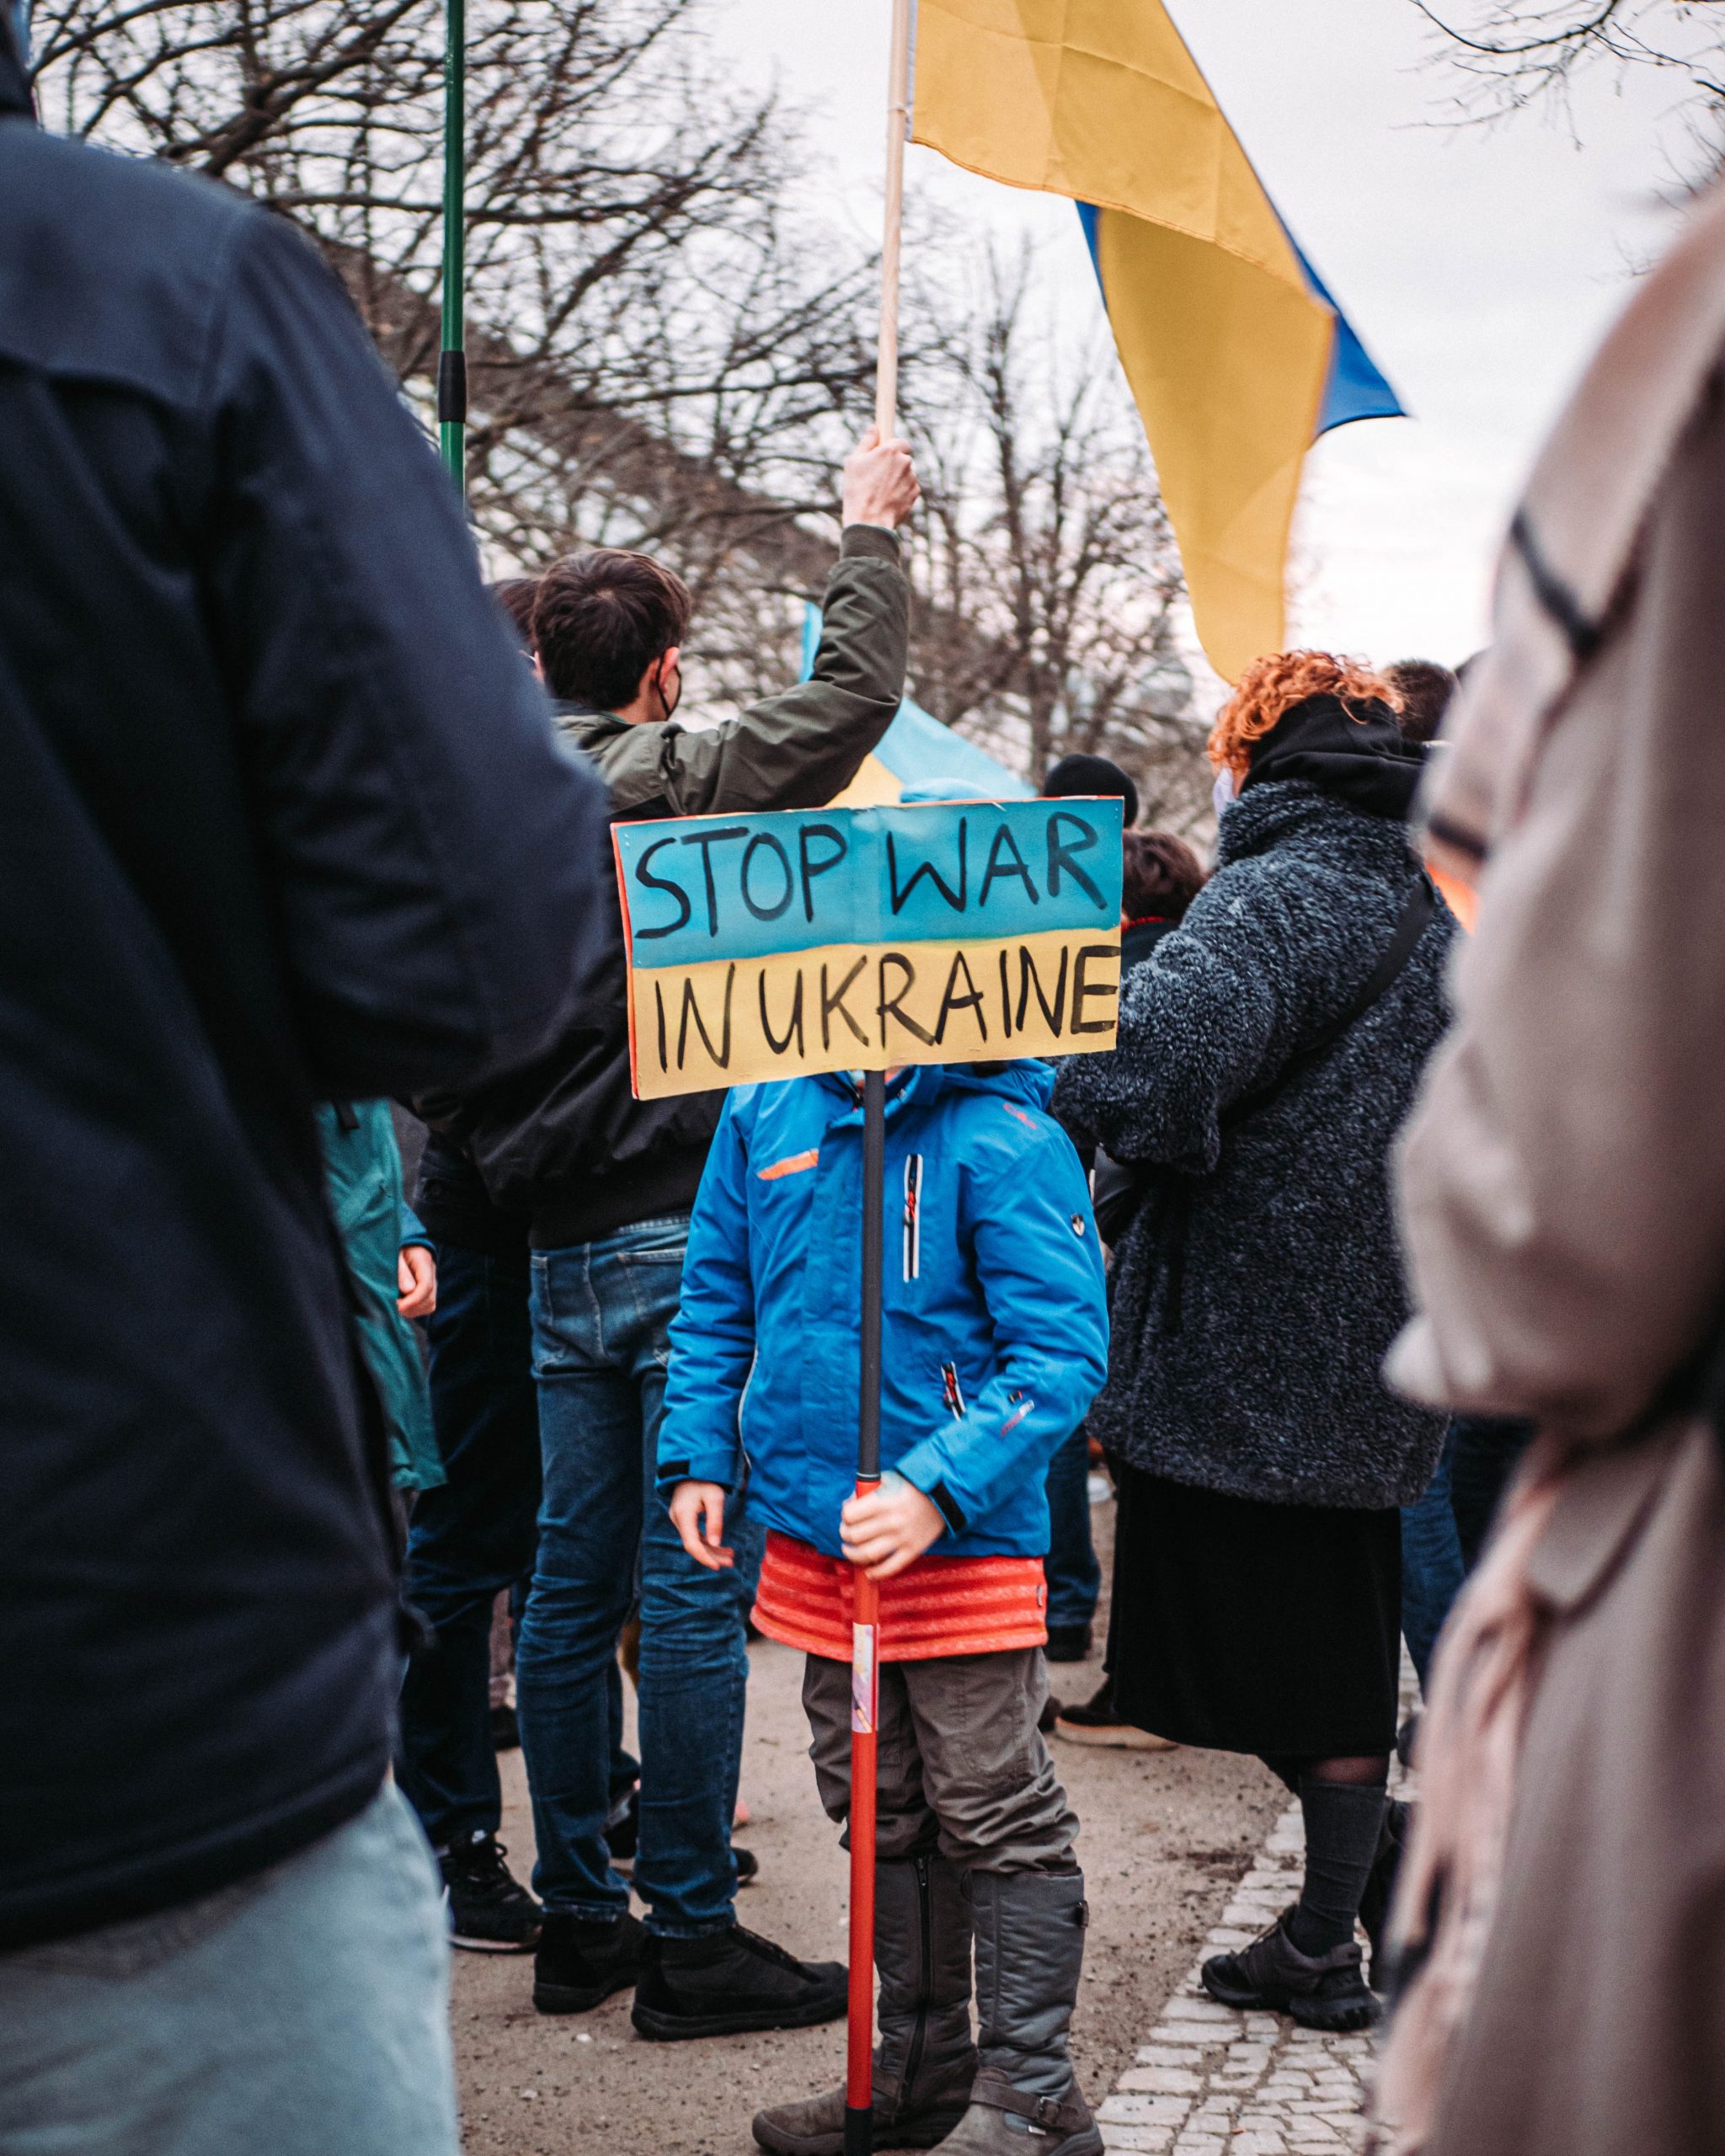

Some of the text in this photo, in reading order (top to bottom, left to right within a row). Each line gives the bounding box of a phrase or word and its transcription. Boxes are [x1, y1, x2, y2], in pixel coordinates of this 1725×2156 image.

[635, 811, 1108, 939] STOP WAR
[654, 945, 1121, 1074] IN UKRAINE
